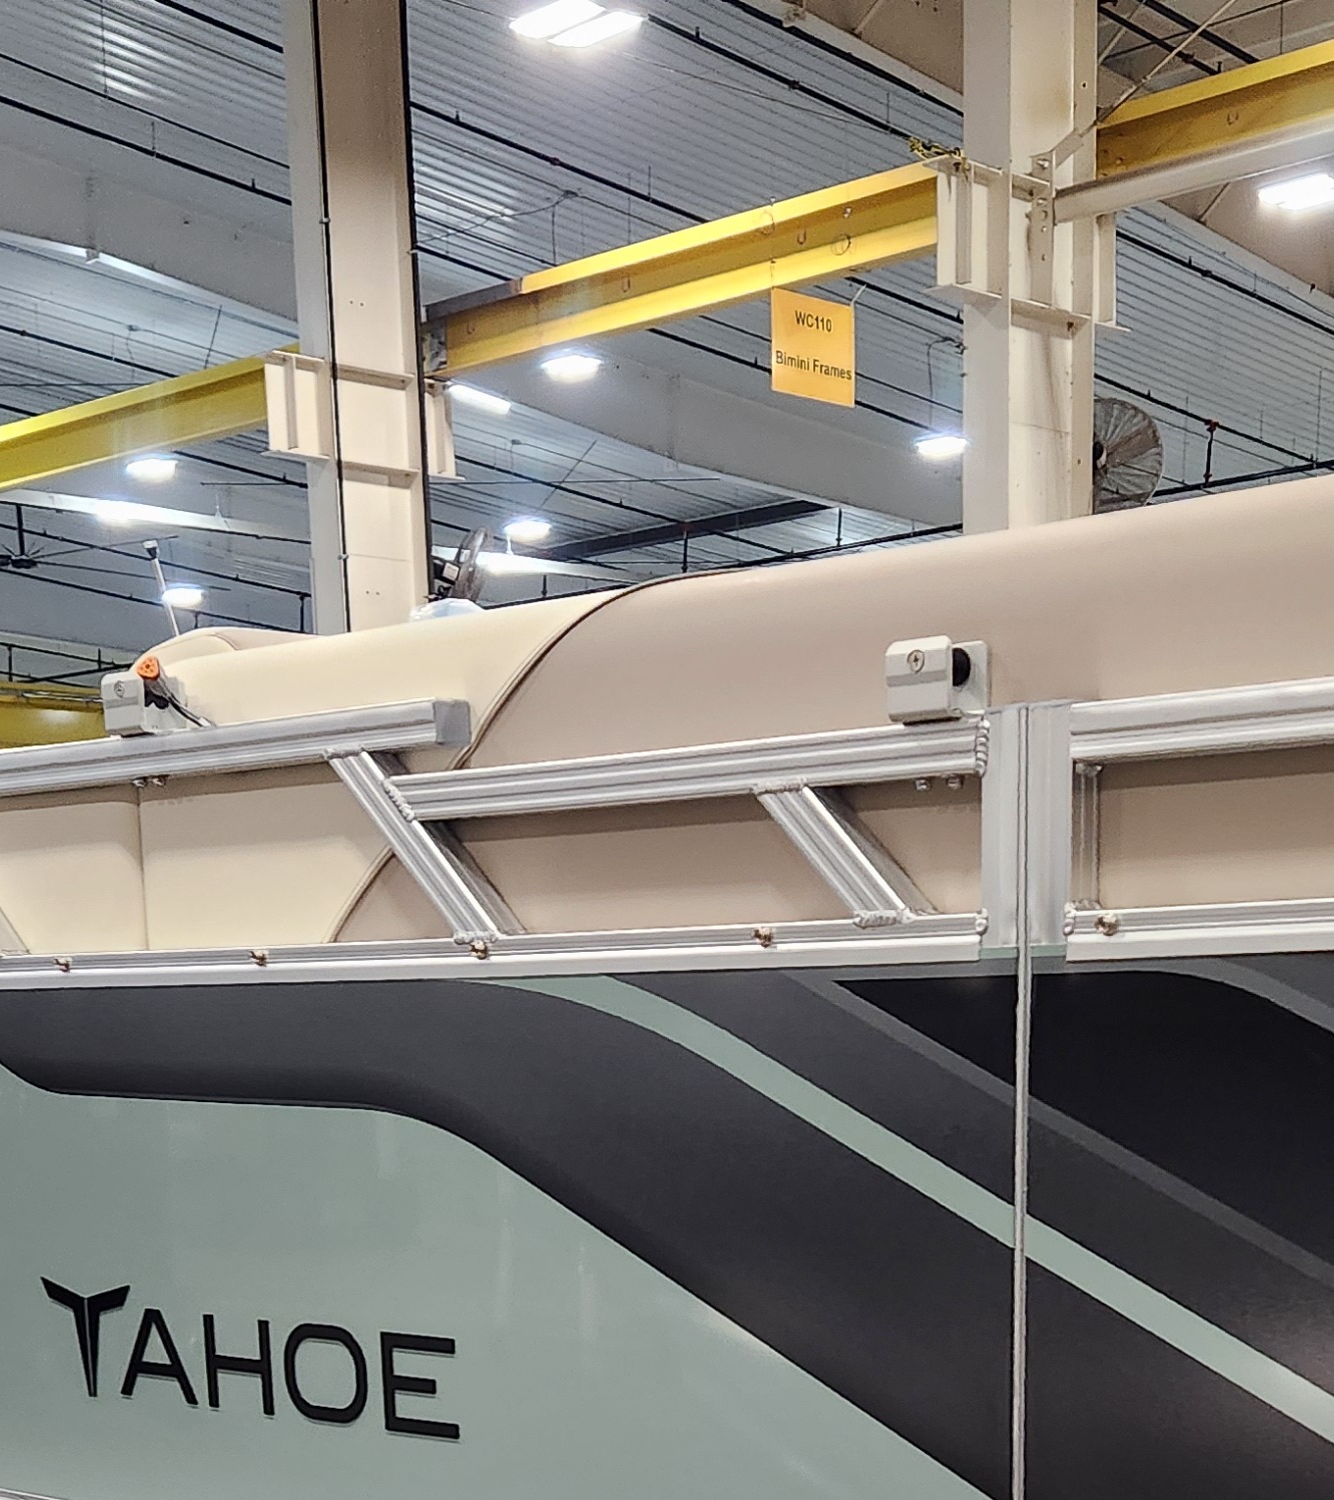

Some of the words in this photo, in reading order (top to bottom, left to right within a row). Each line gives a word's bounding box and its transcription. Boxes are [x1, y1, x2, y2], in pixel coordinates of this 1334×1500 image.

[794, 309, 832, 333] WC110
[775, 349, 810, 371] Bimini
[812, 358, 852, 381] Frames
[39, 1276, 461, 1440] TAHOE
